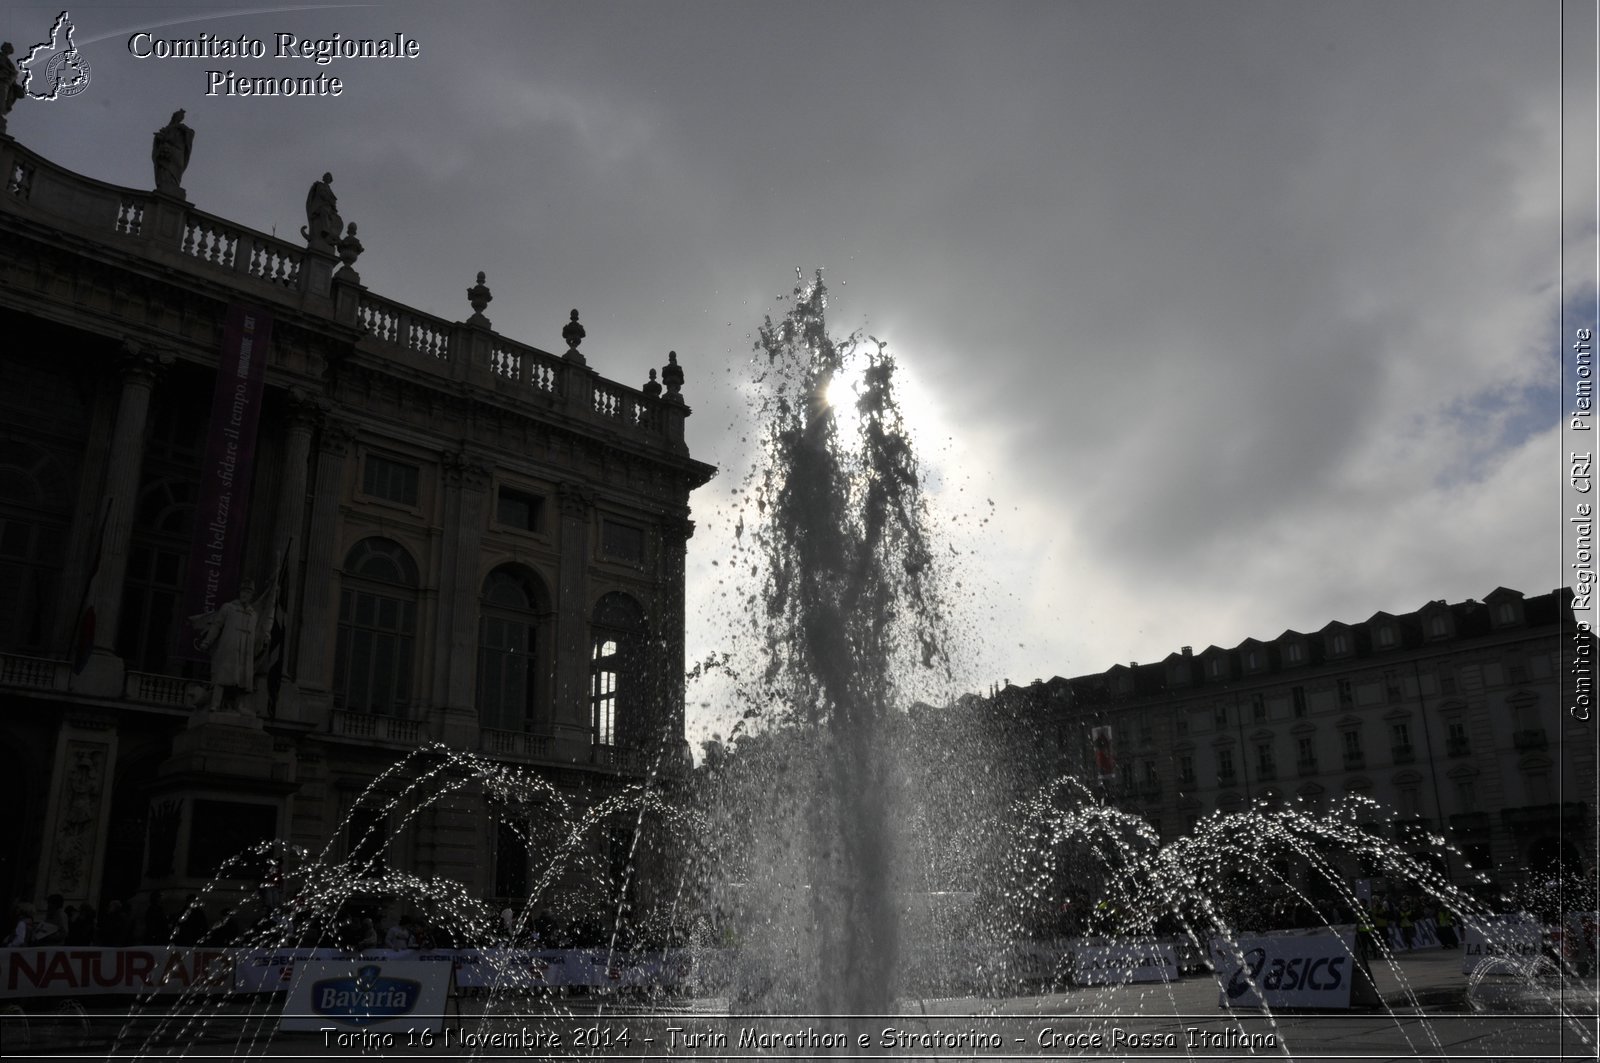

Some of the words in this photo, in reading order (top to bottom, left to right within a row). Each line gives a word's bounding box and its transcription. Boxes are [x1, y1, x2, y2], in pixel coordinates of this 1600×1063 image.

[231, 382, 248, 427] tempo.
[224, 428, 239, 441] il
[217, 442, 238, 488] sfidare
[207, 491, 232, 551] bellezza,
[205, 551, 222, 568] la
[1466, 943, 1482, 956] LA
[321, 985, 407, 1009] Bavaria
